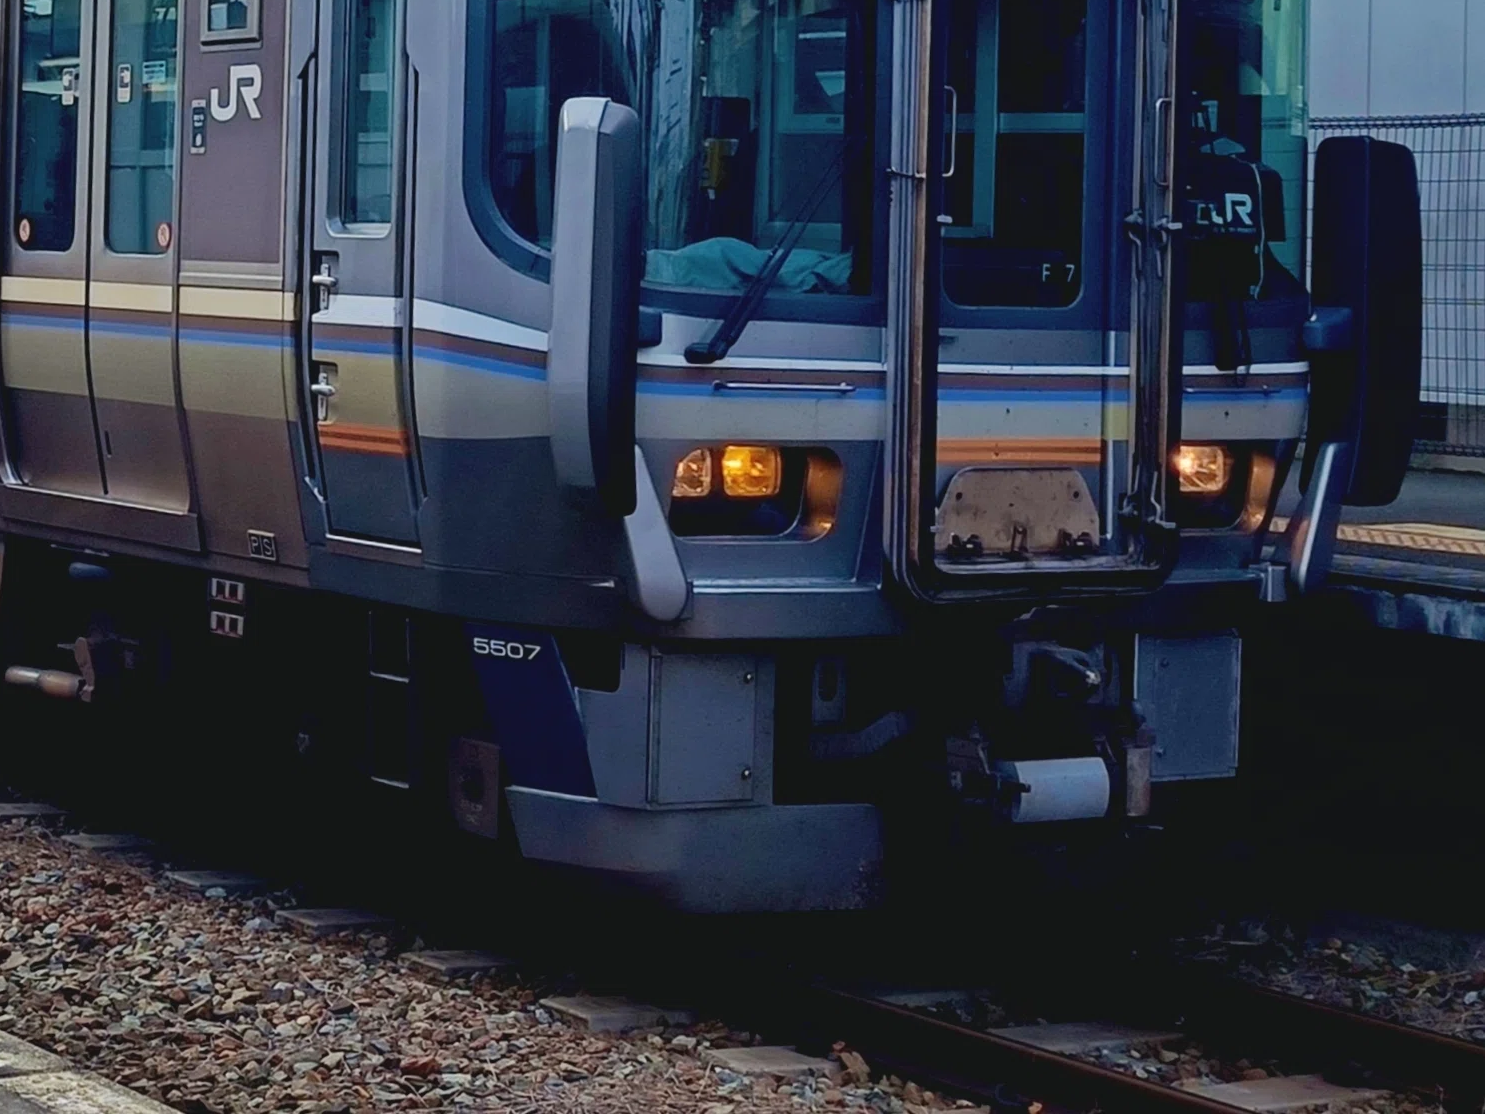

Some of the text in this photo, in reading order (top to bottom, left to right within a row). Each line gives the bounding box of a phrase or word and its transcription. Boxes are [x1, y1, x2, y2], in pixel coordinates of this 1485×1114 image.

[211, 64, 262, 121] JR
[1042, 264, 1075, 282] F 7
[473, 637, 541, 660] 5507
